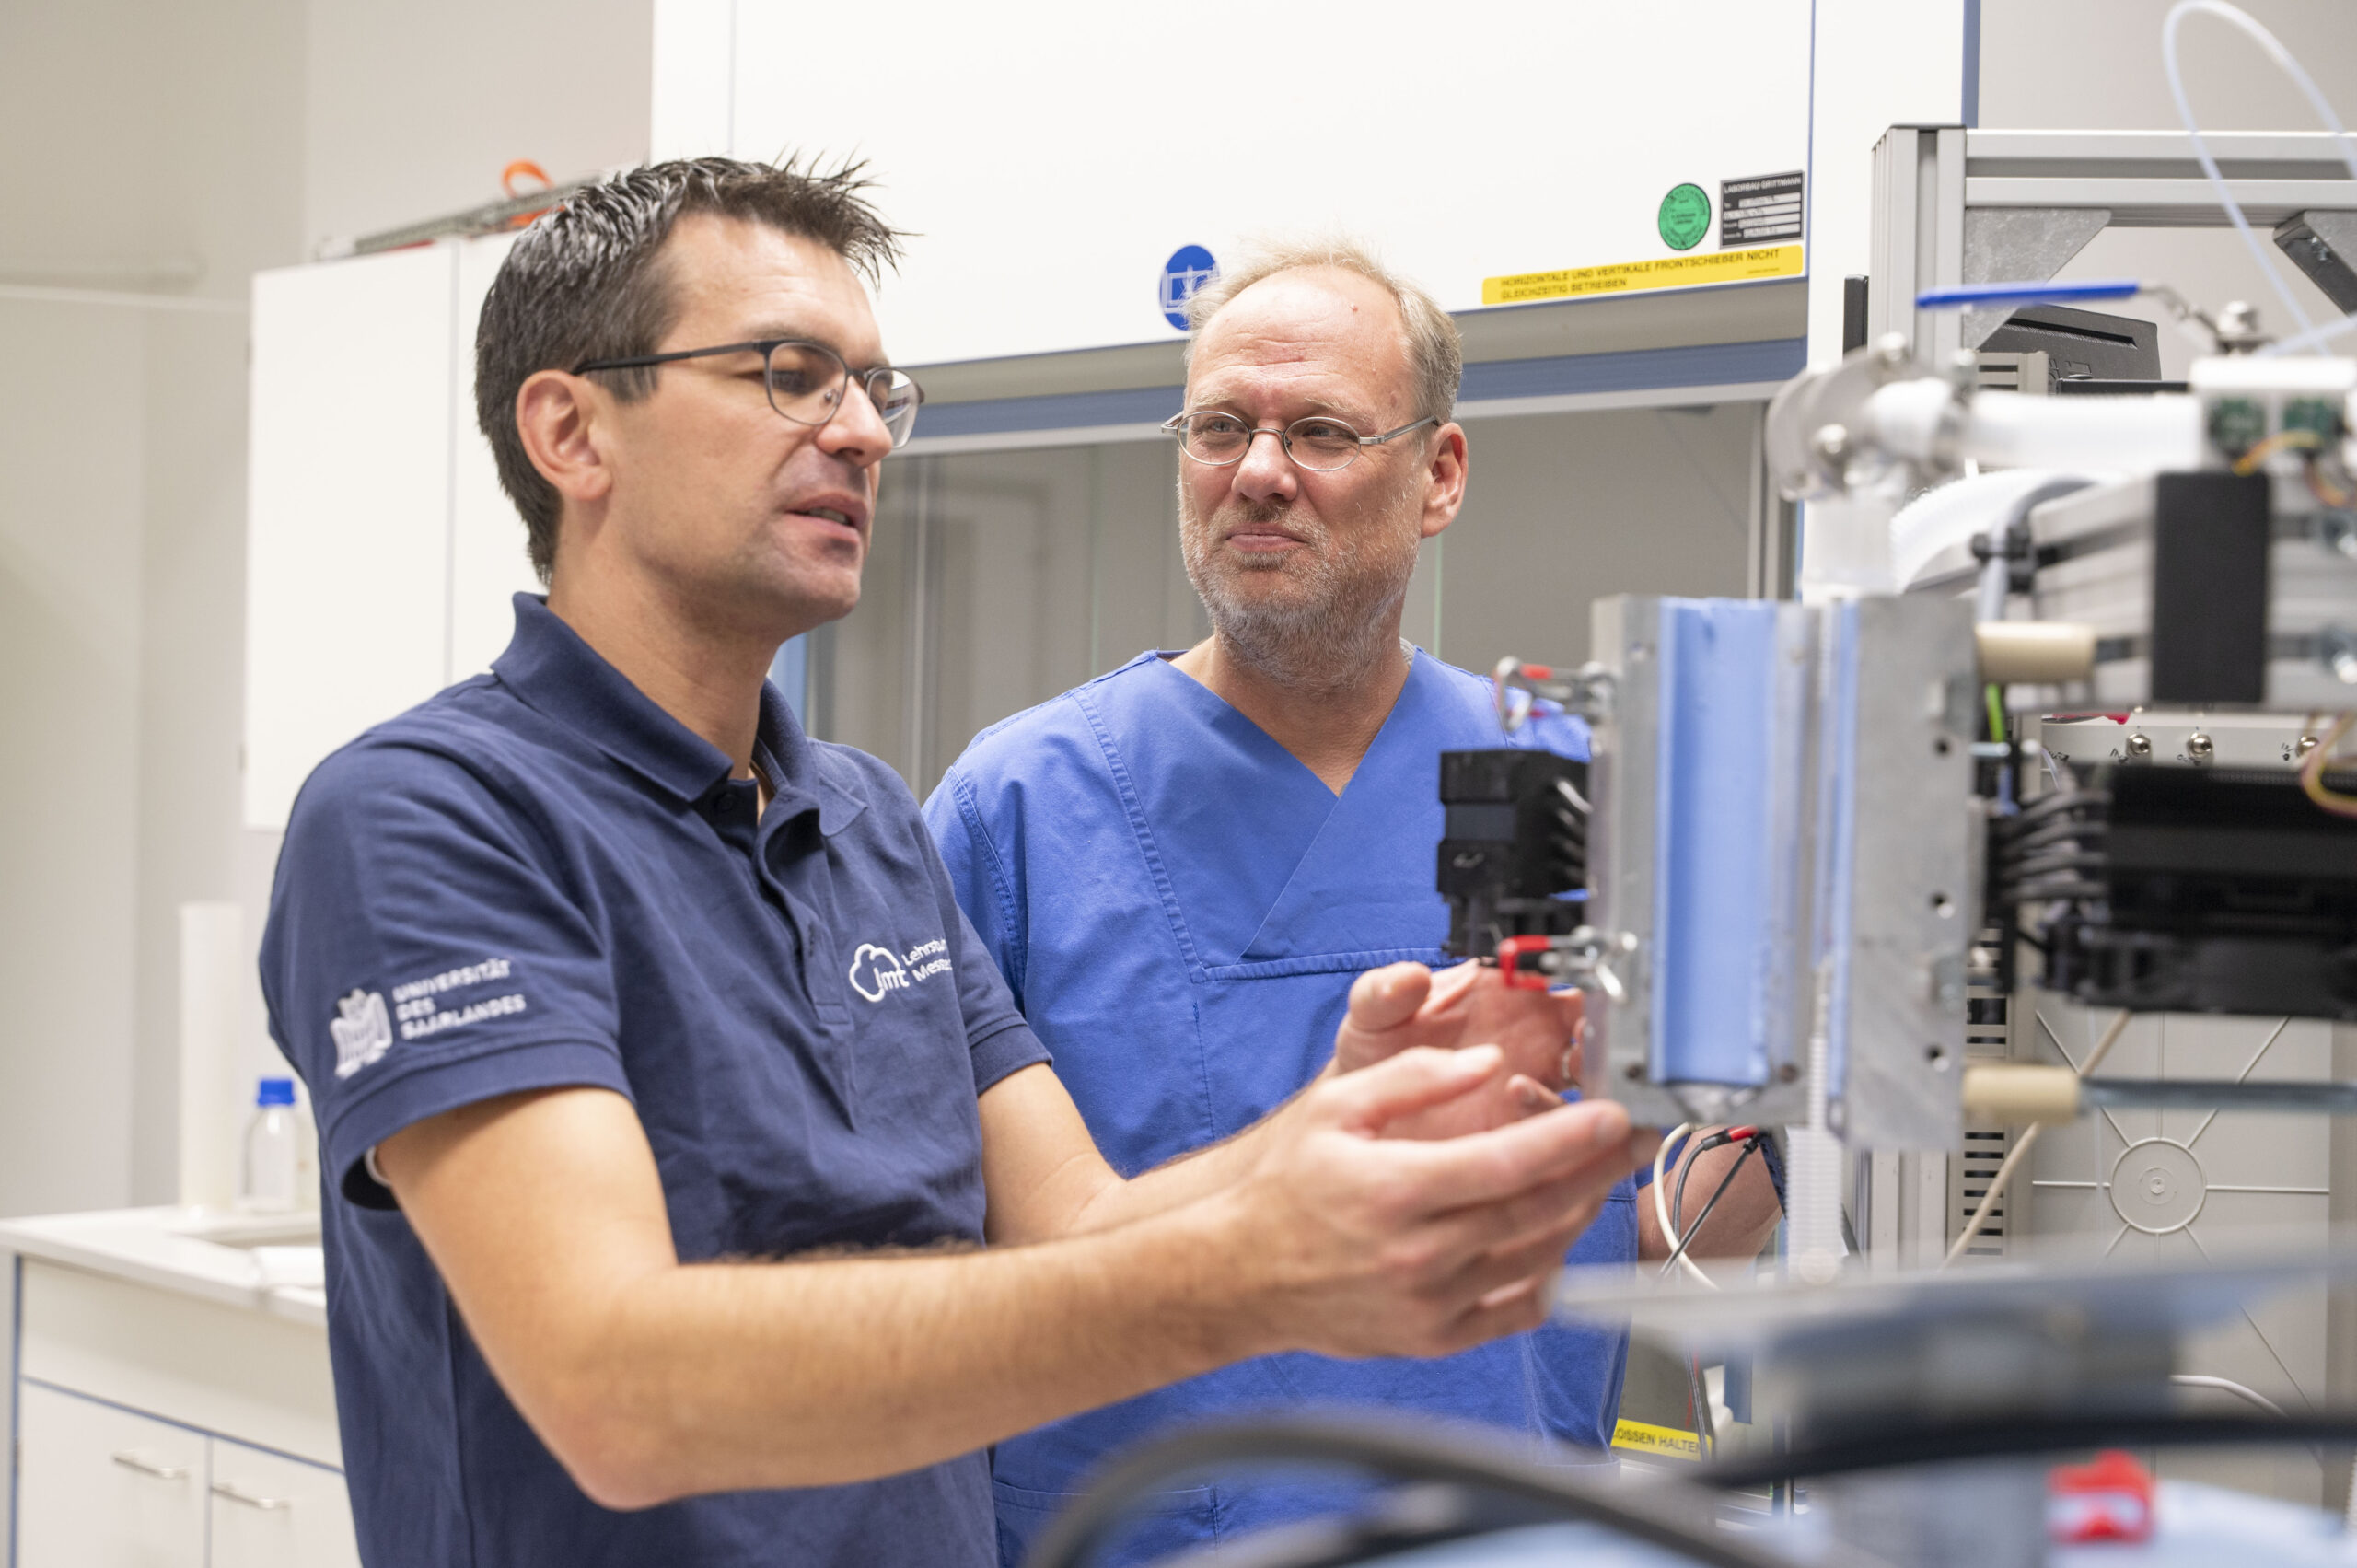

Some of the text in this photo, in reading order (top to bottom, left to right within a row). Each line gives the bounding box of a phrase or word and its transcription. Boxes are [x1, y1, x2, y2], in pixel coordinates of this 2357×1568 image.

[1571, 268, 1594, 280] UND
[1597, 262, 1650, 277] VERTIKALE
[1655, 252, 1743, 271] FRONTSCHIEBER
[1747, 249, 1780, 261] NICHT
[1572, 278, 1627, 292] BETREIBEN
[393, 958, 509, 1002] UNIVERSITÄT
[396, 997, 436, 1022] DES
[401, 994, 526, 1040] SAARLANDES
